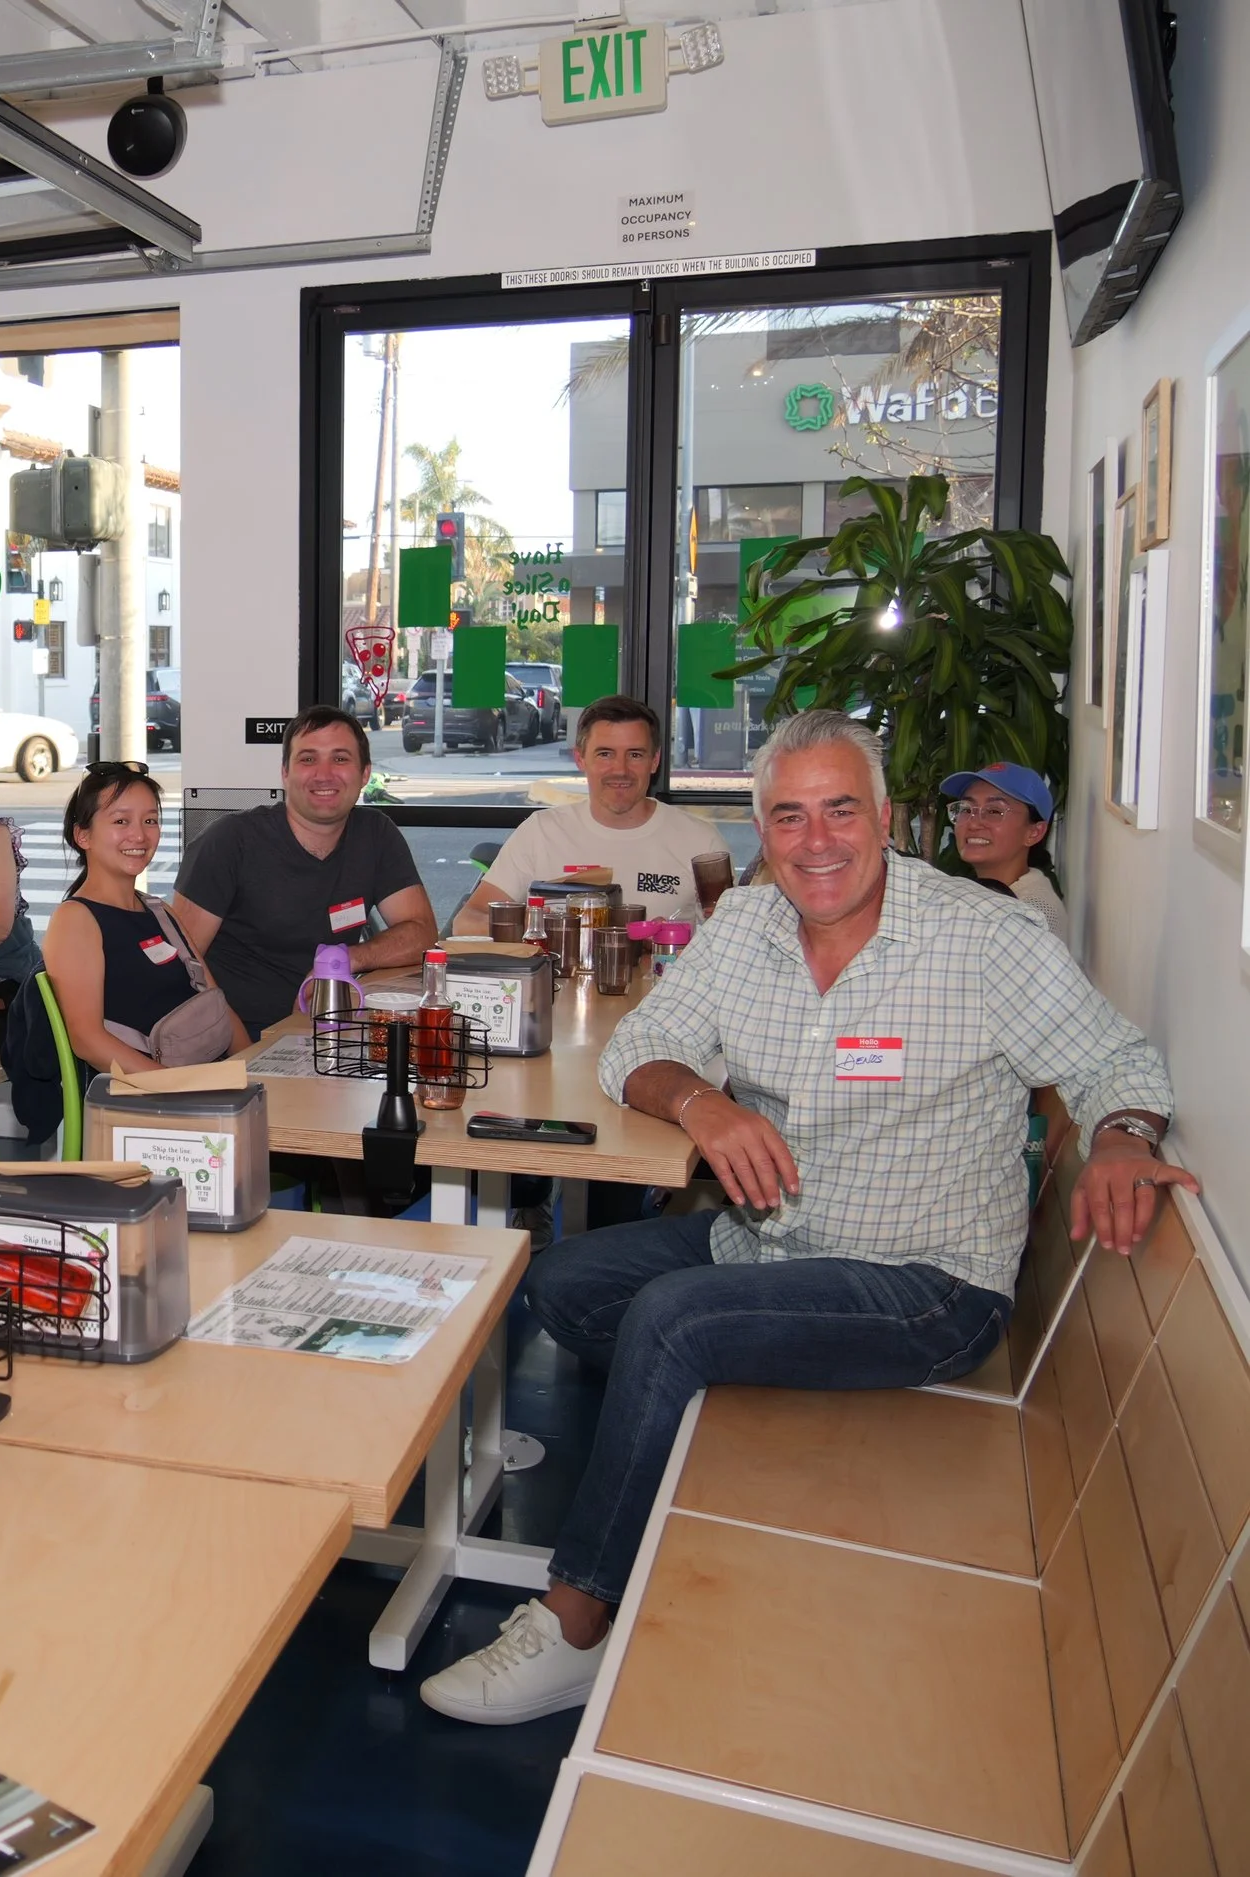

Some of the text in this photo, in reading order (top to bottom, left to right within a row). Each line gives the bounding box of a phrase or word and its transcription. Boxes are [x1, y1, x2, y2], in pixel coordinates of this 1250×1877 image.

[561, 29, 648, 104] EXIT
[628, 193, 684, 207] MAXIMUM
[620, 210, 691, 225] OCCUPANCY
[622, 228, 690, 243] 80 PERSONS
[550, 270, 580, 283] DOOR(S)
[581, 267, 610, 280] SHOULD
[611, 265, 640, 278] REMAIN
[641, 262, 680, 276] UNLOCKED
[682, 260, 706, 273] WHEN
[708, 259, 723, 271] THE
[724, 256, 760, 270] BUILDING
[761, 255, 770, 266] IS
[772, 252, 813, 267] OCCUPIED
[255, 722, 286, 734] EXIT
[637, 872, 681, 886] DRIVERS
[152, 1145, 167, 1153] Skip
[168, 1146, 178, 1154] the
[142, 1152, 158, 1160] We'll
[159, 1154, 175, 1163] bring
[199, 1173, 206, 1181] 3
[23, 1234, 39, 1245] Skip
[41, 1236, 53, 1246] the
